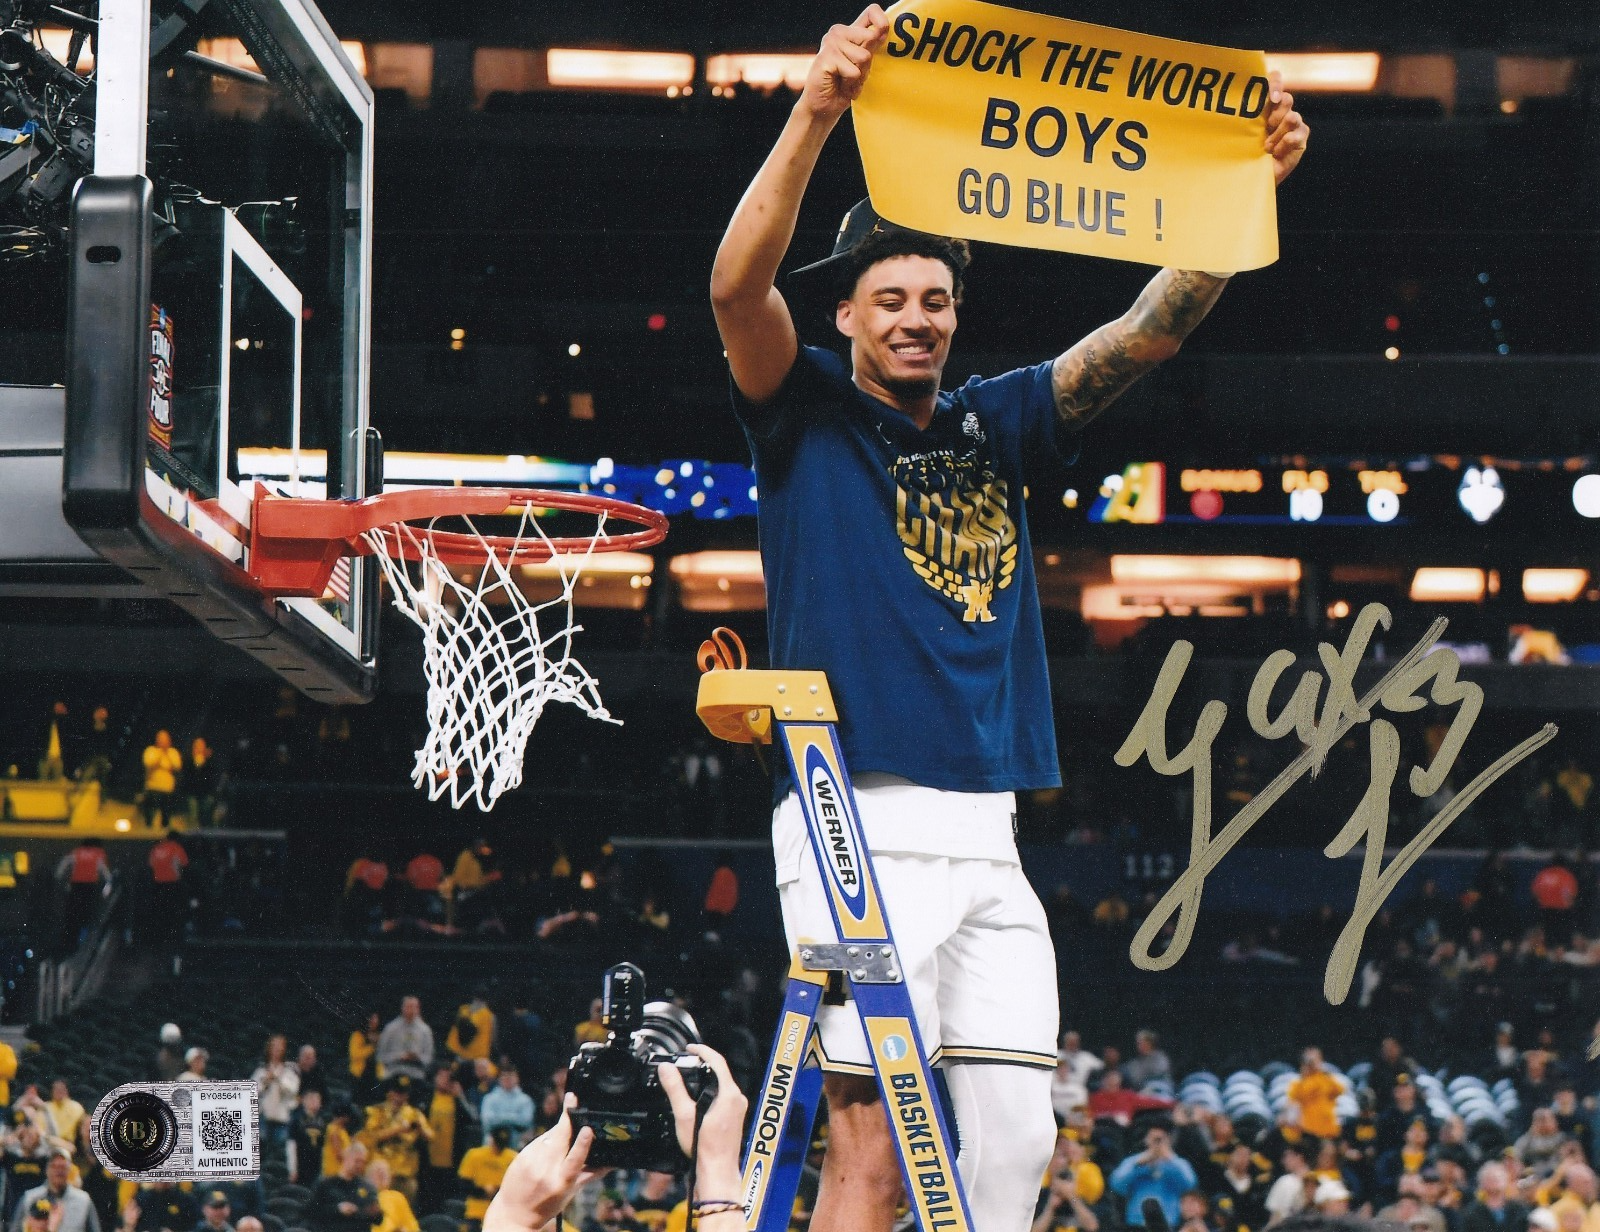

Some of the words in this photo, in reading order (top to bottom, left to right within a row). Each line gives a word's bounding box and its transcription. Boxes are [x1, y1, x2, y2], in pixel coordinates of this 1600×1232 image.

[887, 12, 1036, 78] SHOCK
[1040, 40, 1122, 93] THE
[1126, 55, 1269, 119] WORLD
[980, 97, 1149, 171] BOYS
[957, 168, 1011, 218] GO
[1026, 179, 1126, 236] BLUE
[815, 779, 857, 886] WERNER
[783, 1020, 801, 1060] PODIO
[754, 1063, 793, 1156] PODIUM
[889, 1072, 958, 1232] BASKETBALL
